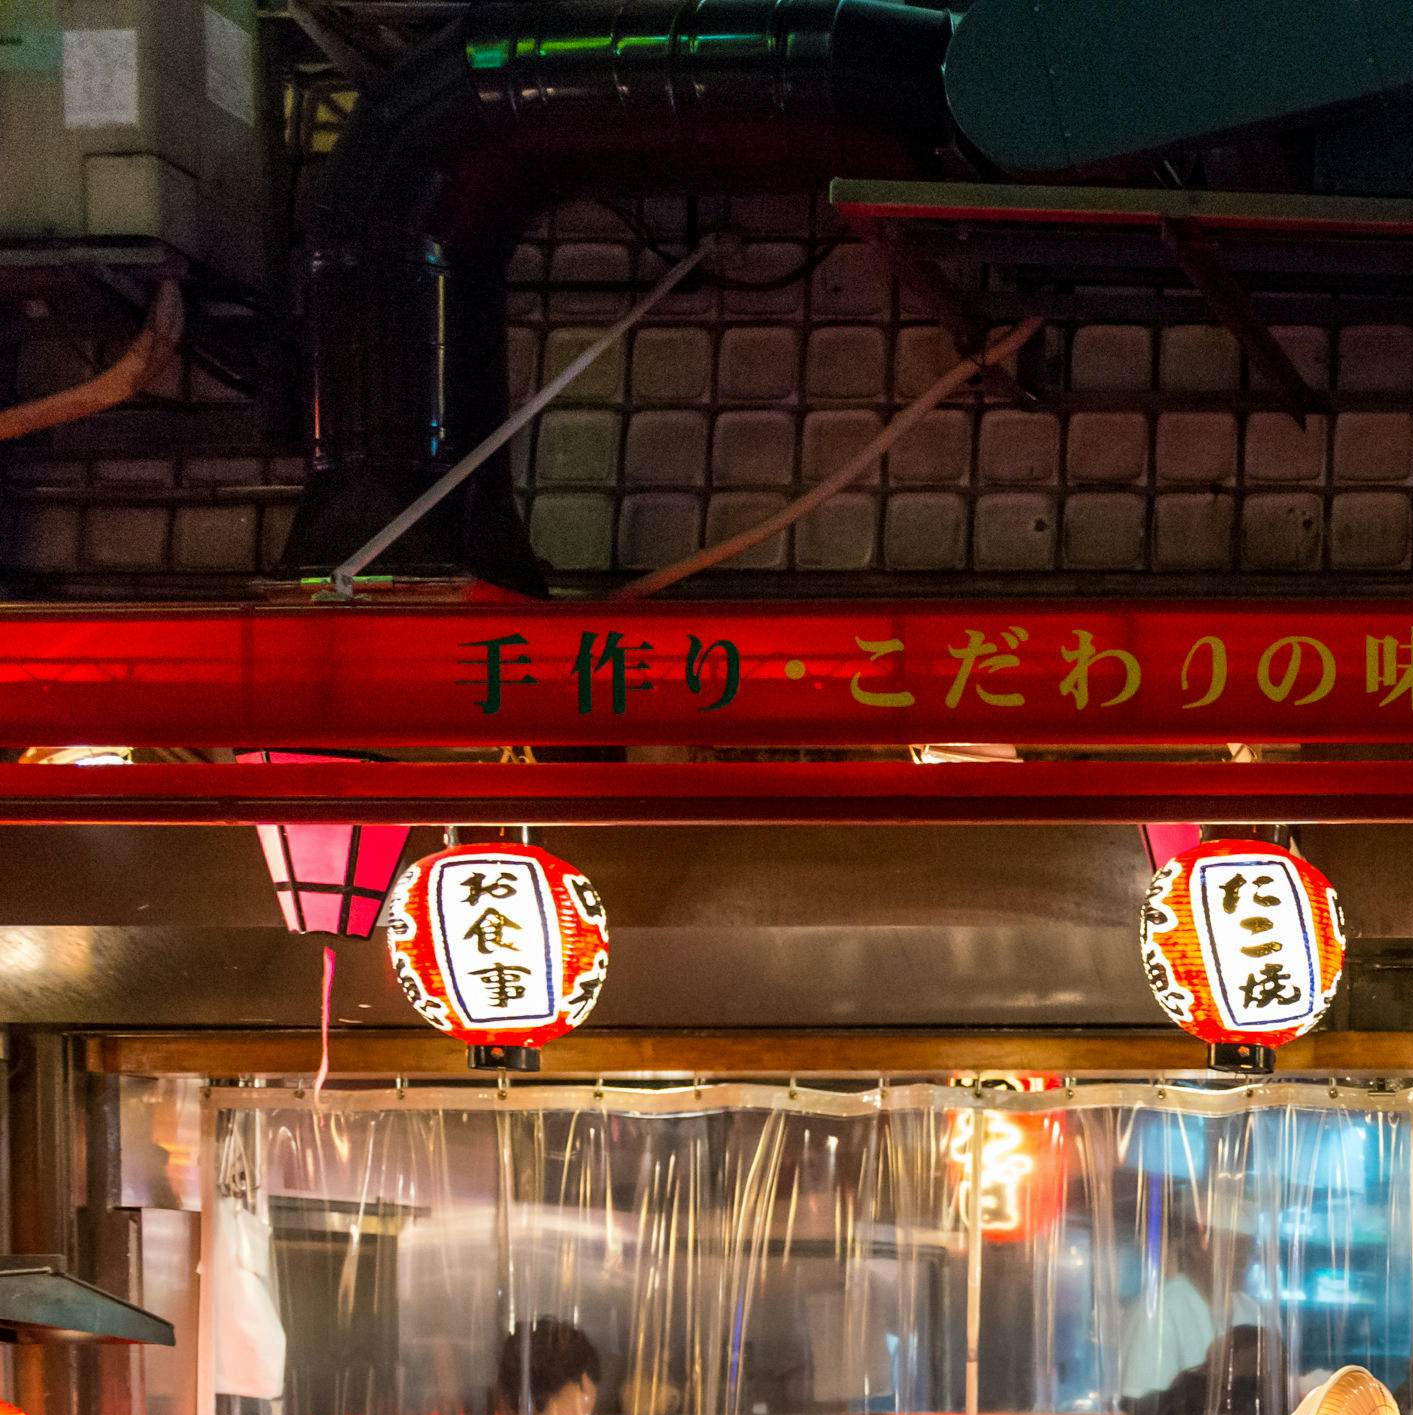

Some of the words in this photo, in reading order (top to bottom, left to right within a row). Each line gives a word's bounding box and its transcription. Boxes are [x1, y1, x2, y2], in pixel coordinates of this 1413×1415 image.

[460, 871, 531, 1008] お食事
[1219, 873, 1301, 1009] たこ焼
